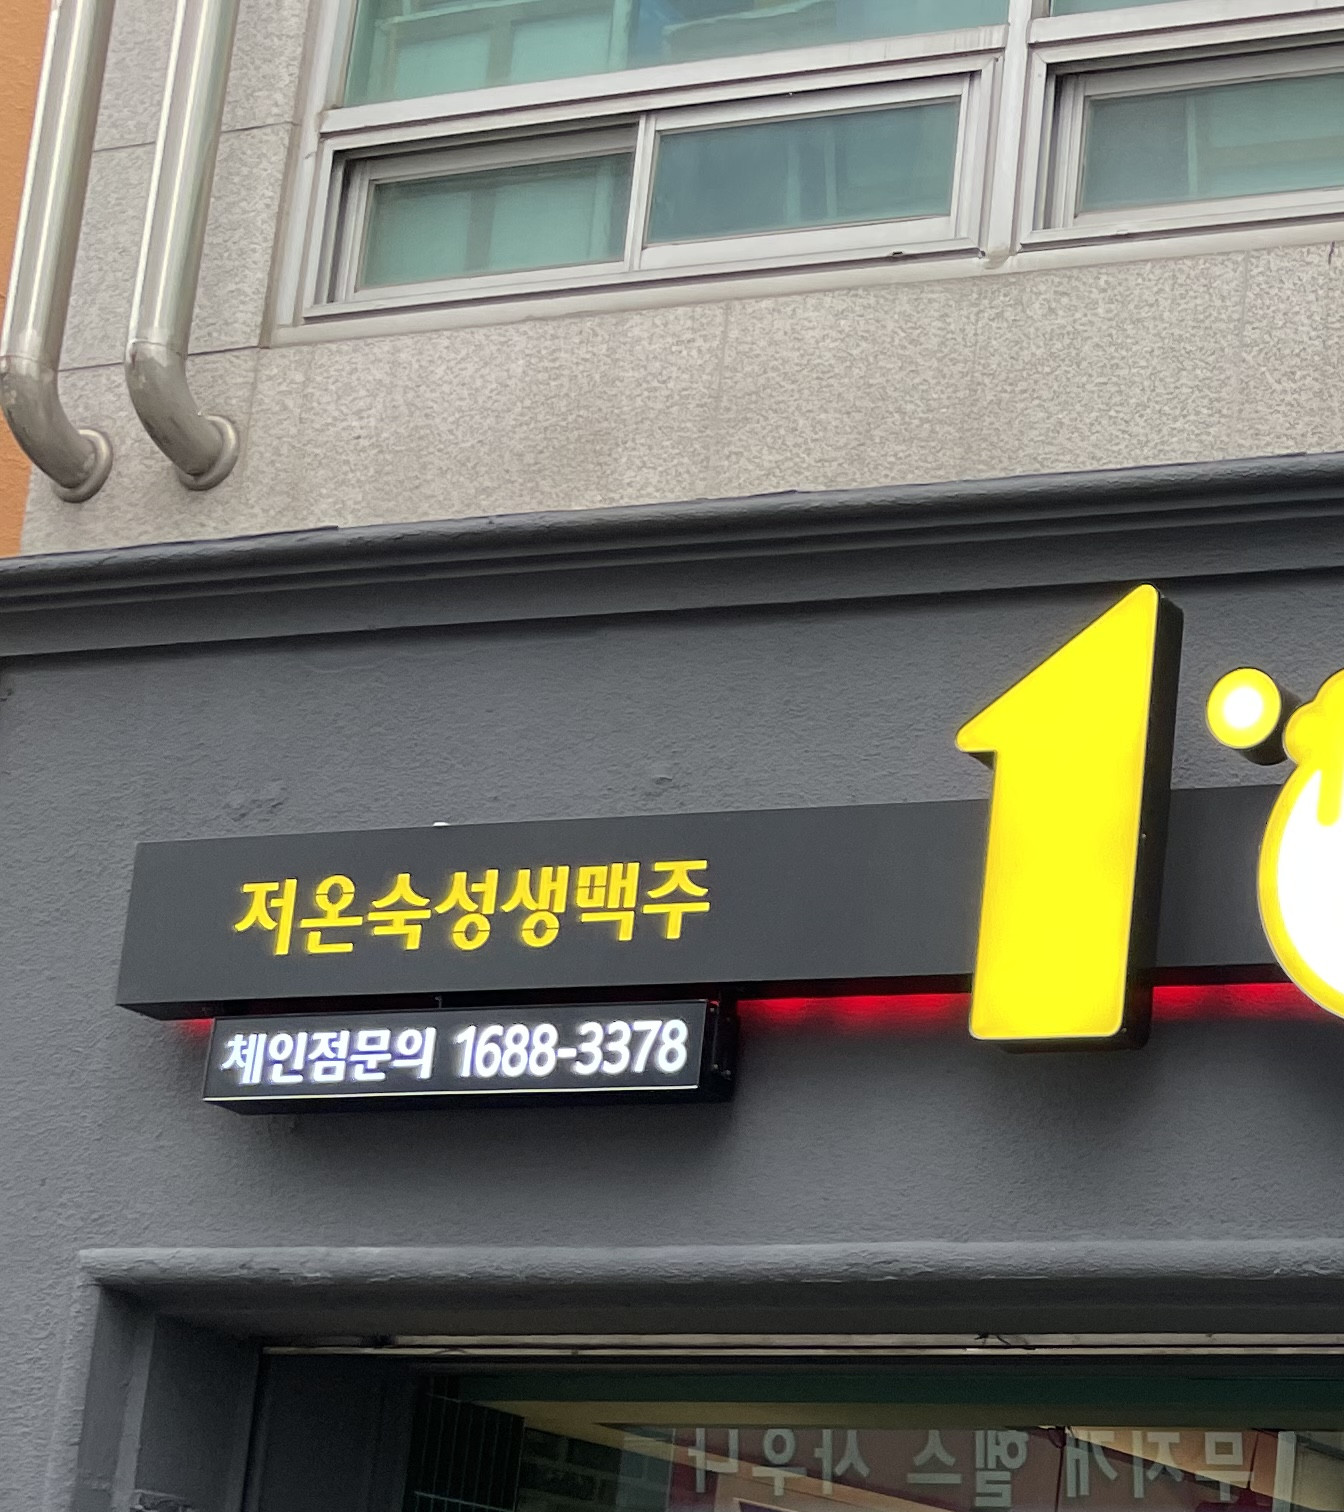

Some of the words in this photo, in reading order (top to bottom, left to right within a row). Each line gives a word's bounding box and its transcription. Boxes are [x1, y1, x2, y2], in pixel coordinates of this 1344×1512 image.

[234, 859, 710, 956] 저온숙성생맥주
[220, 1031, 437, 1086] 체인점문의
[454, 1019, 688, 1078] 1688-3378
